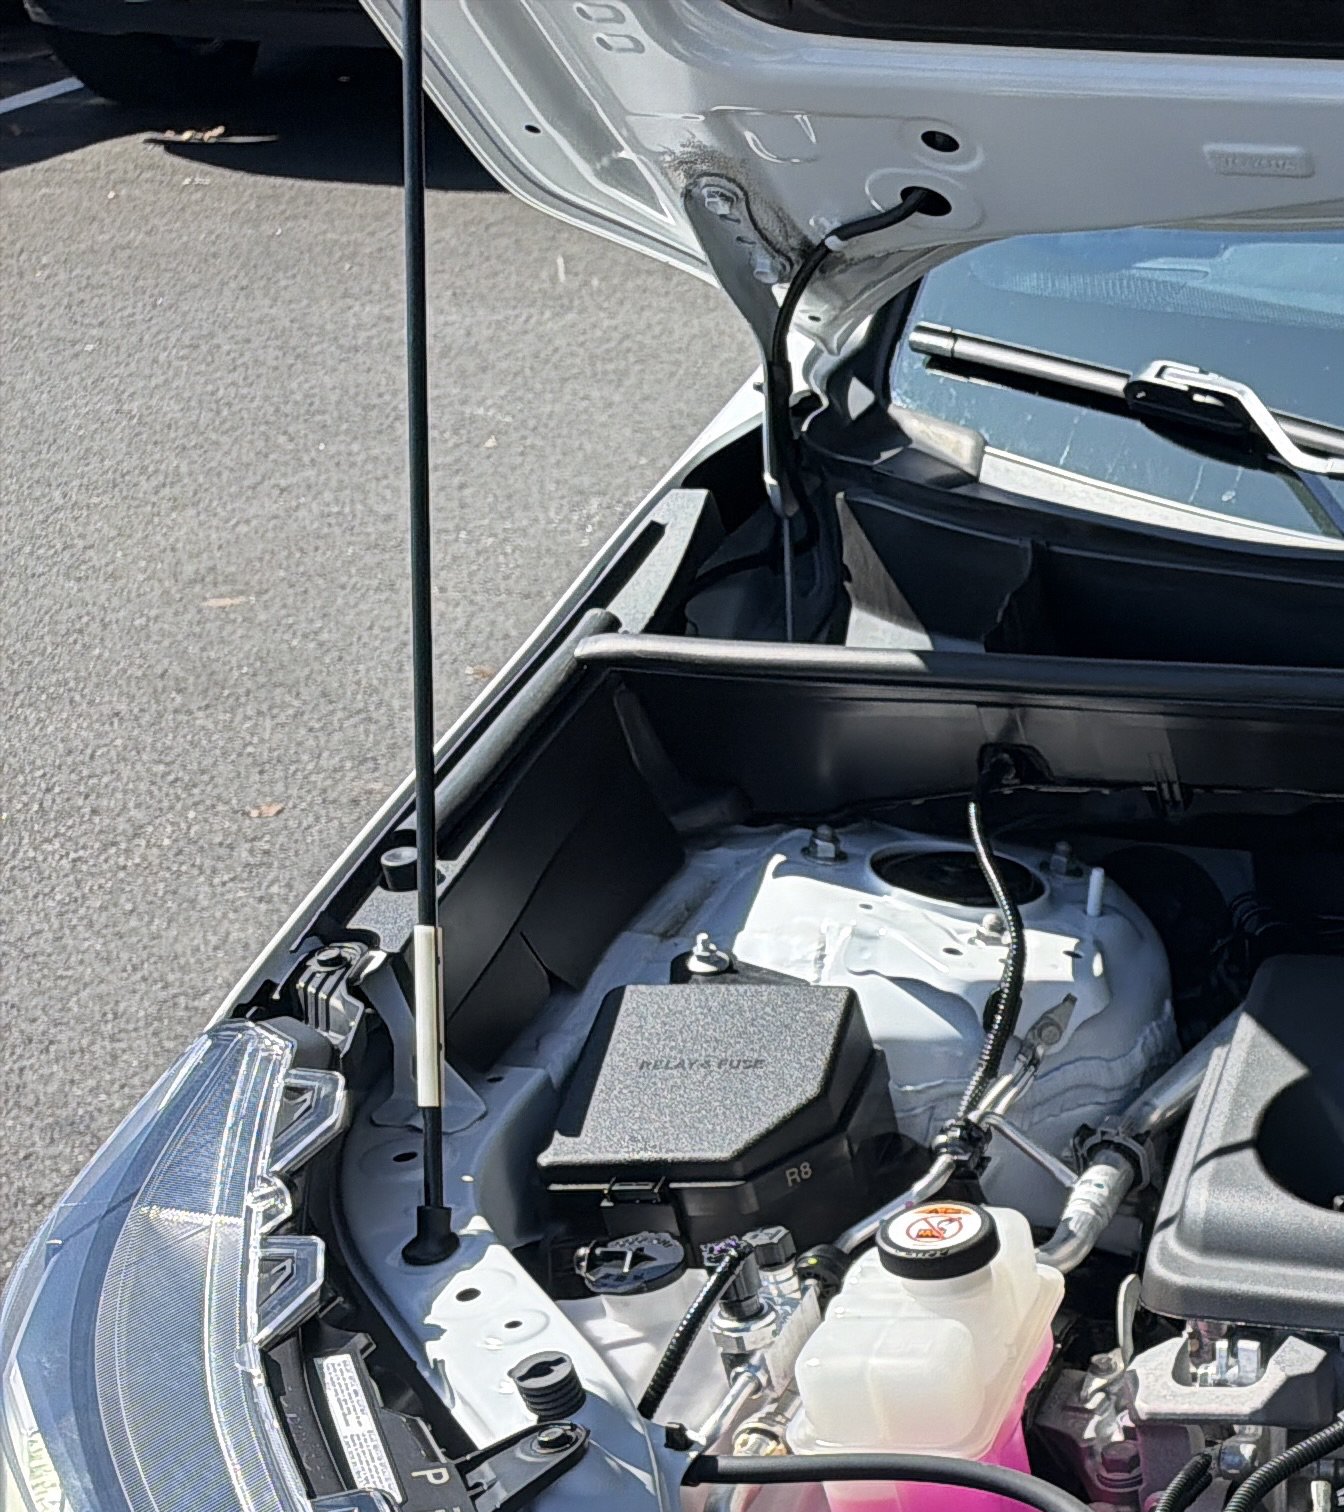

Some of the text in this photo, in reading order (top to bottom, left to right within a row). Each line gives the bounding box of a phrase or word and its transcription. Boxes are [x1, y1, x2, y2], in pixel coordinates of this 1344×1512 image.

[717, 1059, 765, 1070] FUSE
[785, 1161, 812, 1187] R8
[411, 1467, 450, 1486] P
